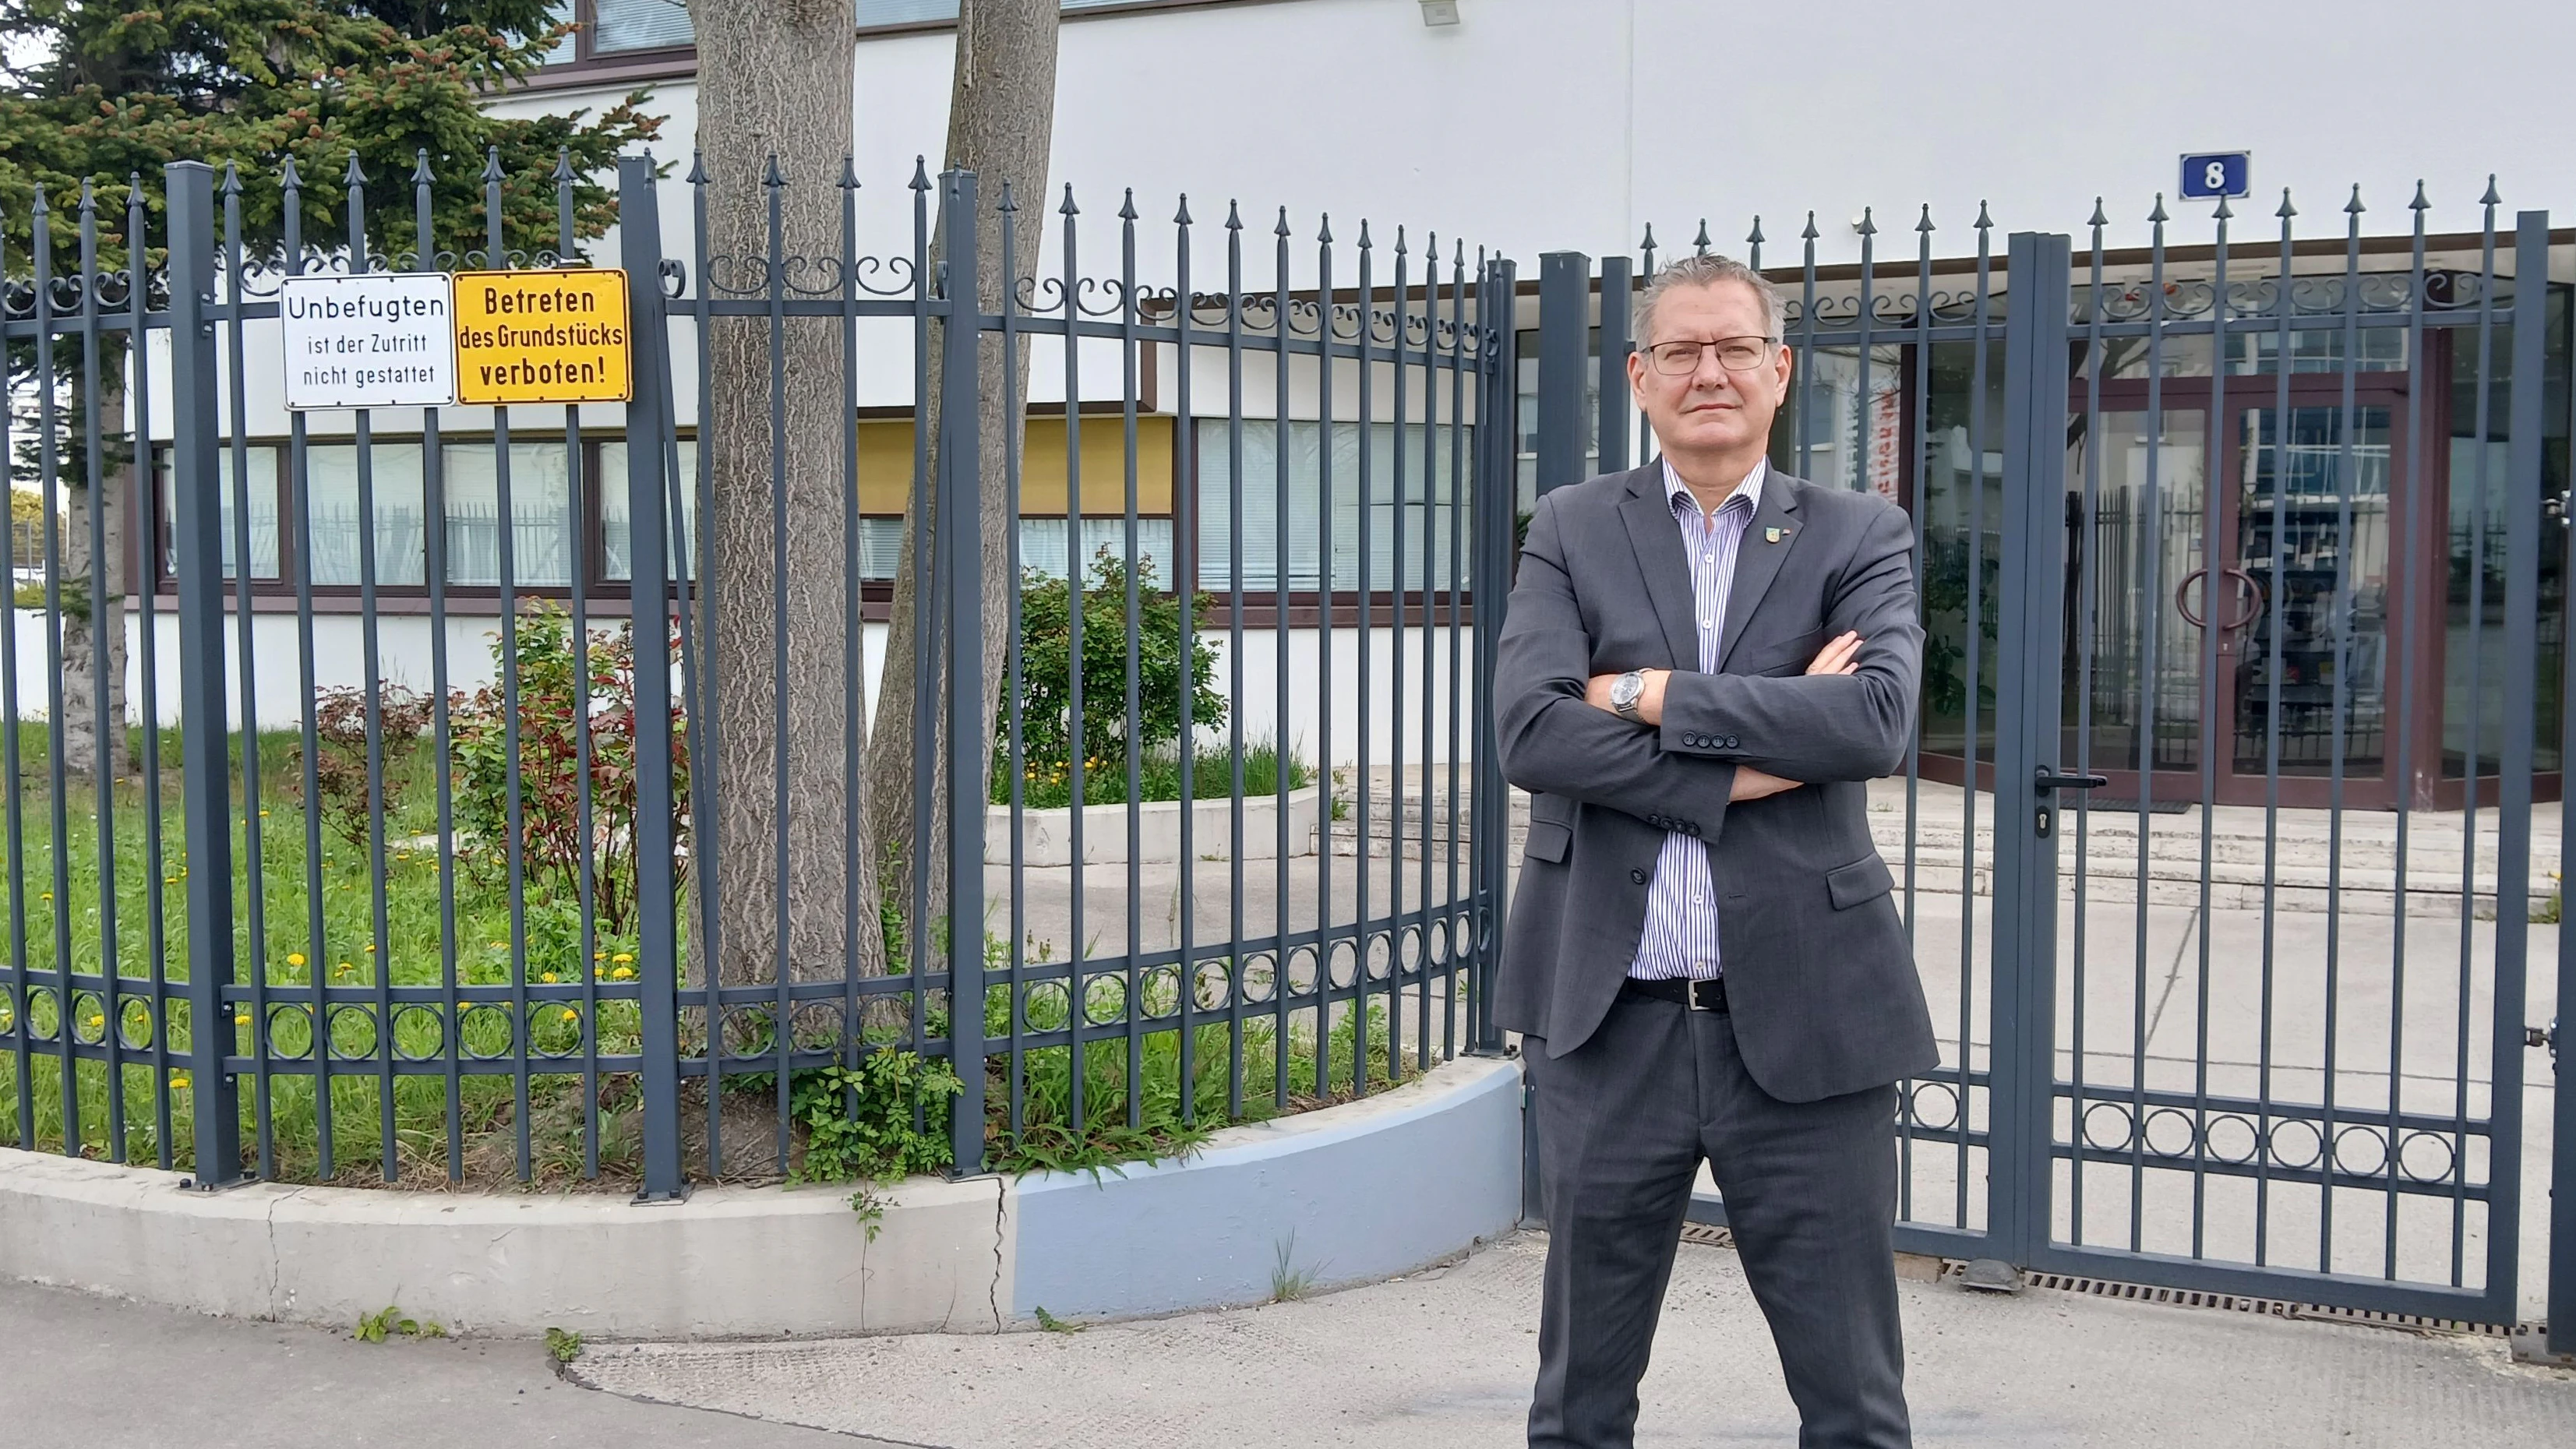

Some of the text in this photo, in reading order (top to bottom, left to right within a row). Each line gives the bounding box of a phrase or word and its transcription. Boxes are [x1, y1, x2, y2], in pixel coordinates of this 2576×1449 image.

[2205, 161, 2225, 189] 8
[288, 294, 444, 323] Unbefugten
[485, 287, 595, 315] Betreten
[308, 333, 427, 354] ist der Zutritt
[459, 321, 623, 349] des Grundstücks
[303, 365, 435, 389] nicht gestattet
[479, 355, 605, 386] verboten!
